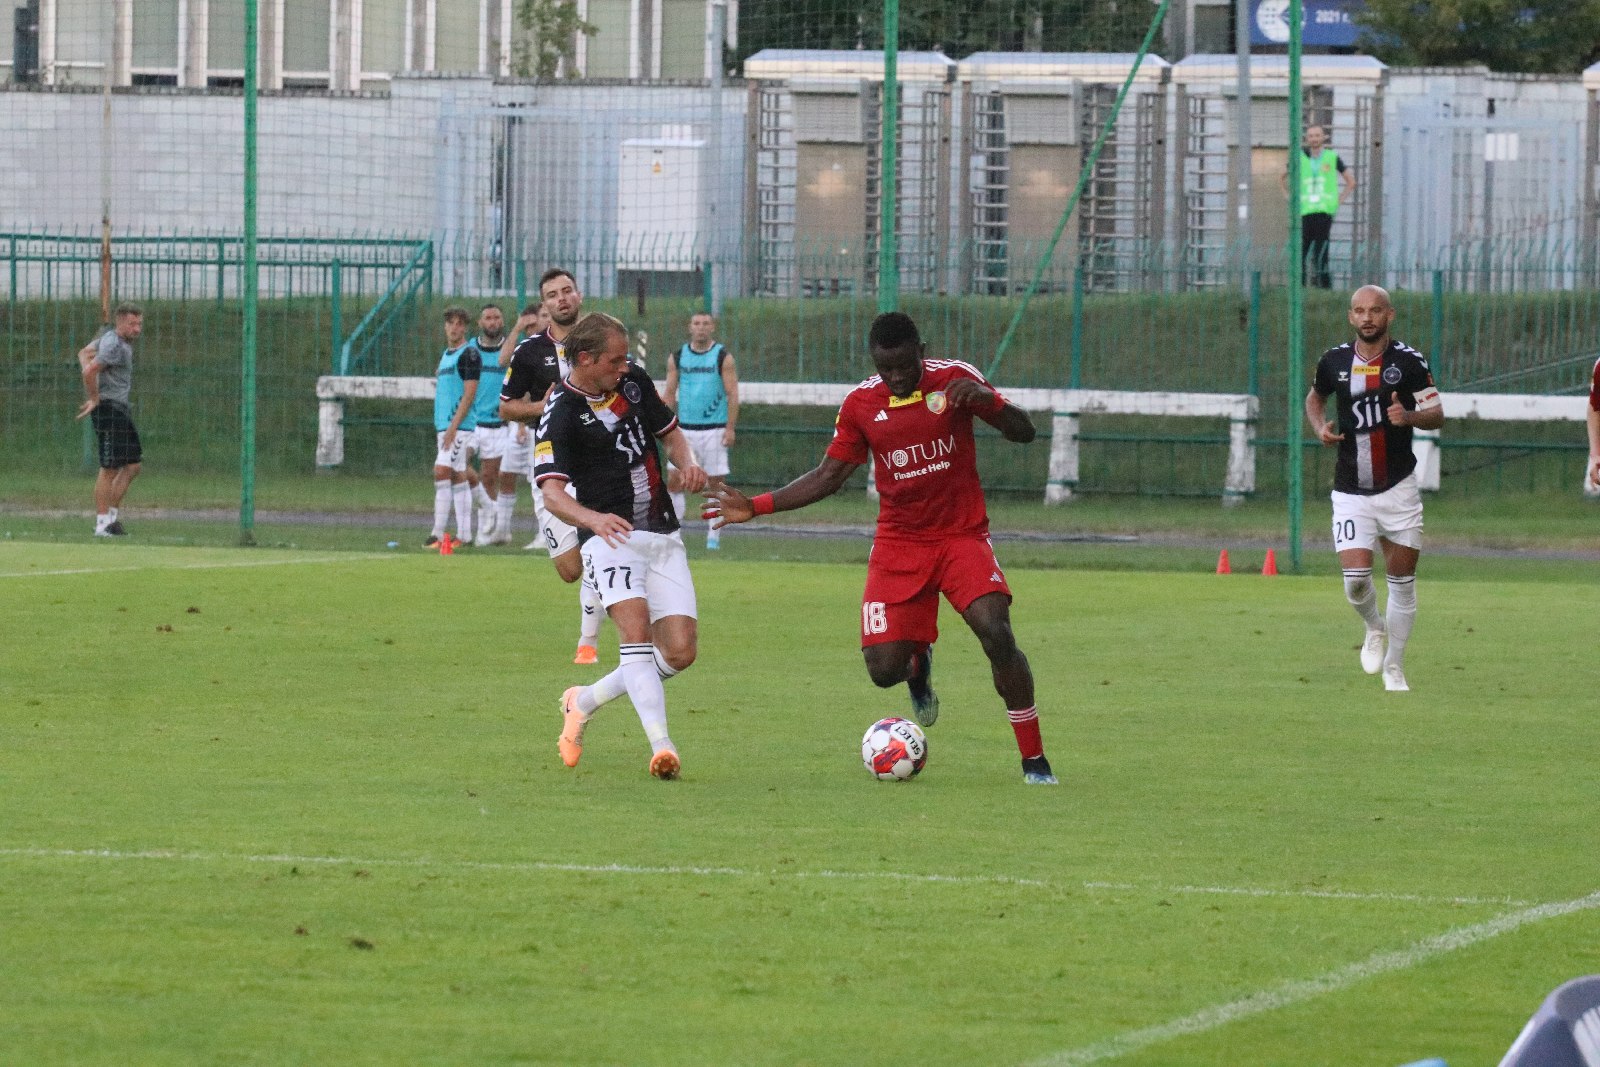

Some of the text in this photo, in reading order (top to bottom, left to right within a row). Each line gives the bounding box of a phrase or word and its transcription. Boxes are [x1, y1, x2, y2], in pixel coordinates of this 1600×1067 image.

[879, 435, 957, 470] VOTUM
[893, 460, 951, 481] Finance Help
[1336, 519, 1355, 544] 20
[602, 566, 632, 590] 77
[862, 601, 887, 636] 18
[894, 725, 922, 756] SELECT
